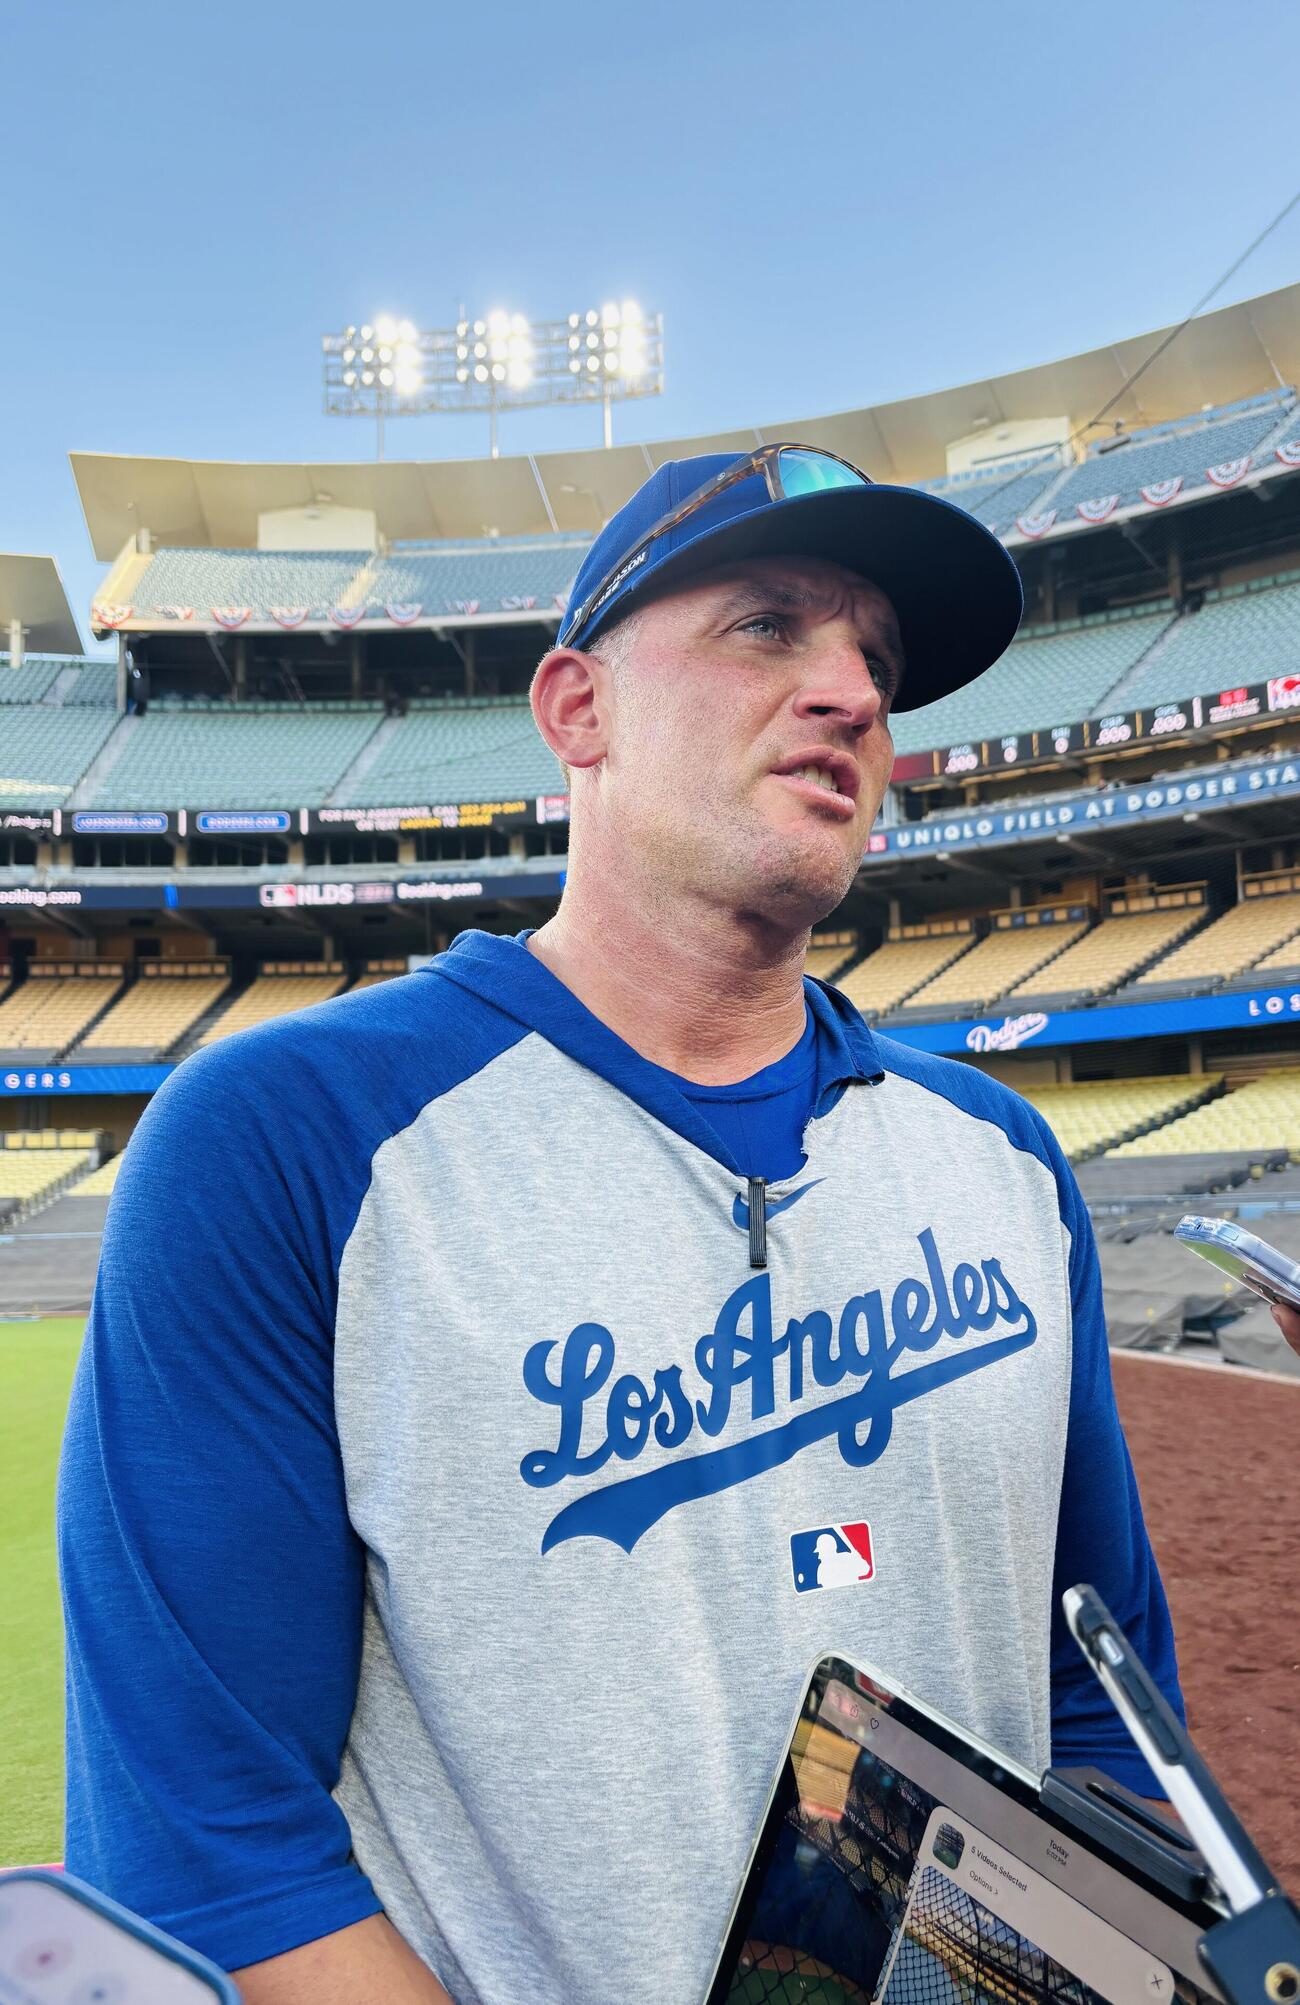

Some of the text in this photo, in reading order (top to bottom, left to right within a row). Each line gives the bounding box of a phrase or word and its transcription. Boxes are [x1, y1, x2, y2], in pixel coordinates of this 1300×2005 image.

[896, 819, 994, 848] UNIQLO
[1004, 806, 1074, 832] FIELD
[1086, 798, 1115, 819] AT
[1127, 776, 1238, 812] DODGER
[1249, 765, 1299, 790] STA
[297, 883, 354, 906] NLDS
[398, 882, 483, 900] Booking.com
[966, 1012, 1048, 1053] Dodgers
[5, 1073, 71, 1089] GERS
[520, 1227, 1037, 1488] Los Angeles
[1049, 1840, 1069, 1858] Today
[969, 1870, 993, 1893] Options
[977, 1850, 998, 1871] Videos
[998, 1866, 1028, 1892] Selected
